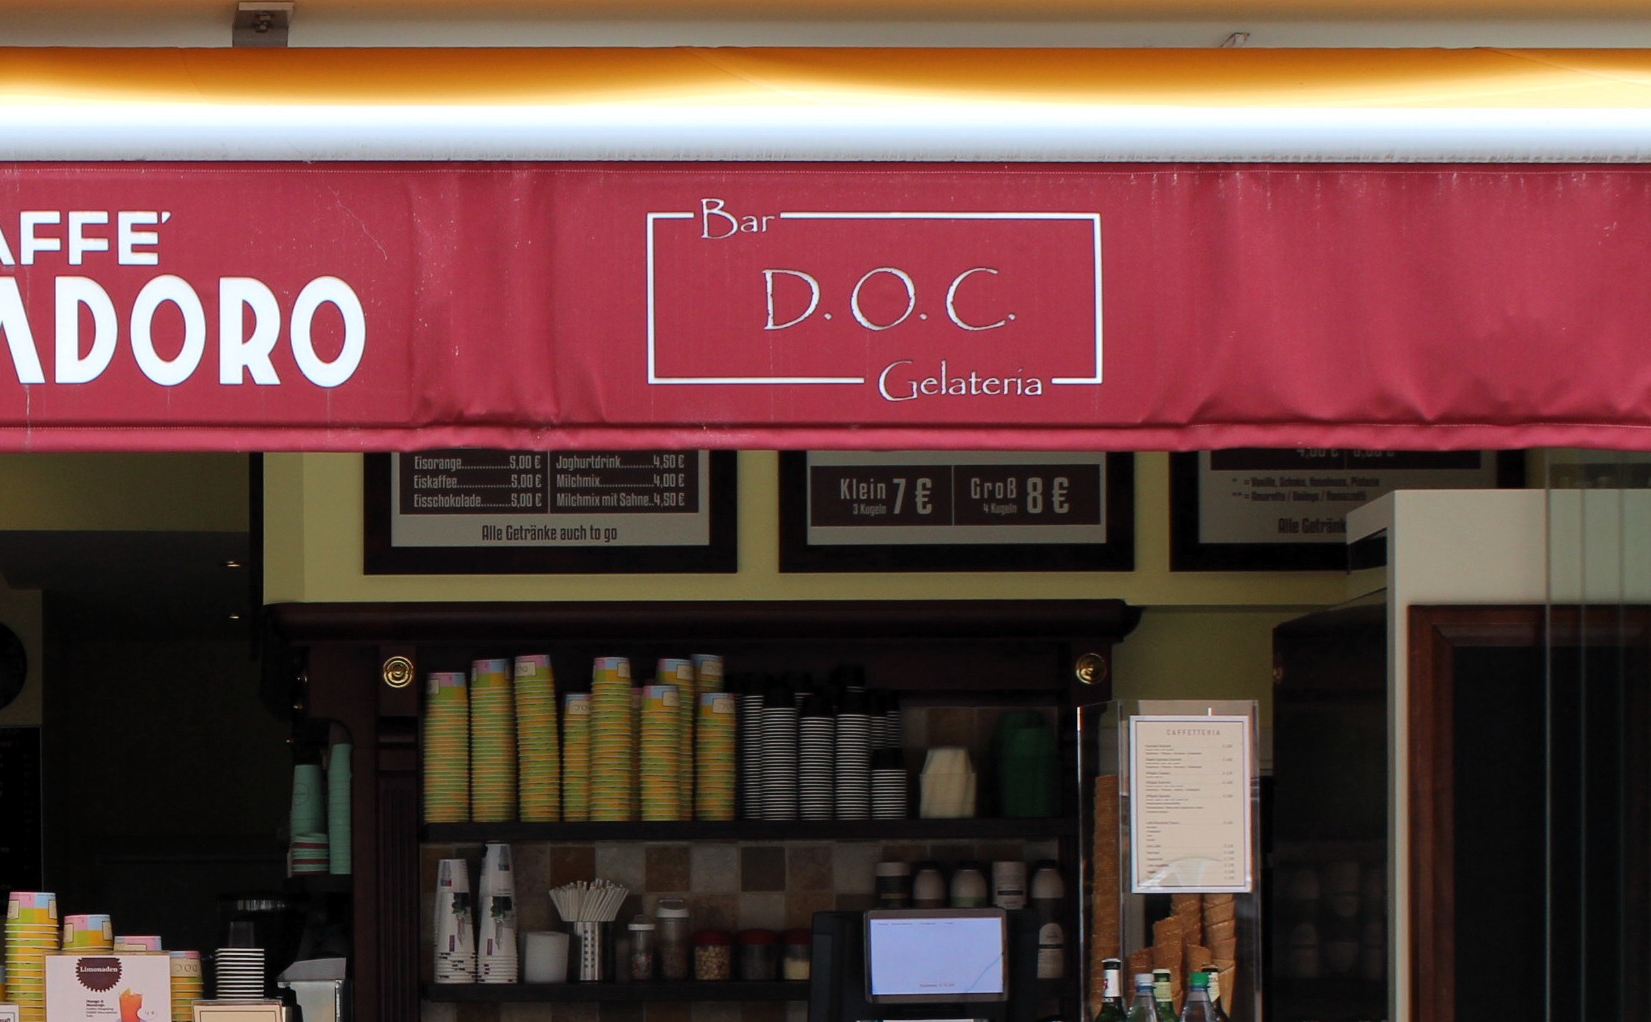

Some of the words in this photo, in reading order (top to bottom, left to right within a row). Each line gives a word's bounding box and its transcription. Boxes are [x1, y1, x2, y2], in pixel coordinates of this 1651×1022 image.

[700, 198, 775, 239] Bar
[878, 359, 1043, 402] Gelateria
[534, 455, 542, 469] €
[556, 455, 621, 471] Joghurtdrink
[677, 455, 684, 469] €
[511, 474, 533, 489] 5,00
[535, 475, 542, 488] €
[556, 473, 600, 488] Milchmix
[678, 474, 685, 488] €
[414, 493, 481, 507] Eisschokolade
[511, 493, 533, 508] 5,00
[535, 493, 542, 507] €
[556, 493, 600, 507] Milchmix
[602, 493, 618, 506] mit
[620, 493, 650, 507] Sahne
[678, 493, 685, 507] €
[840, 478, 887, 500] Klein
[892, 478, 907, 515] 7
[915, 477, 933, 515] €
[970, 477, 1017, 499] Groß
[1026, 477, 1044, 514] 8
[1052, 477, 1069, 514] €
[860, 503, 887, 517] Kugeln
[482, 524, 503, 541] Alle
[505, 523, 558, 541] Getränke
[560, 524, 587, 541] auch
[590, 524, 602, 540] to
[604, 528, 618, 543] go
[1278, 518, 1299, 533] Alle
[1301, 518, 1347, 534] Getränk
[1166, 729, 1221, 737] CAFFETTERIA
[79, 965, 119, 973] Limonaden
